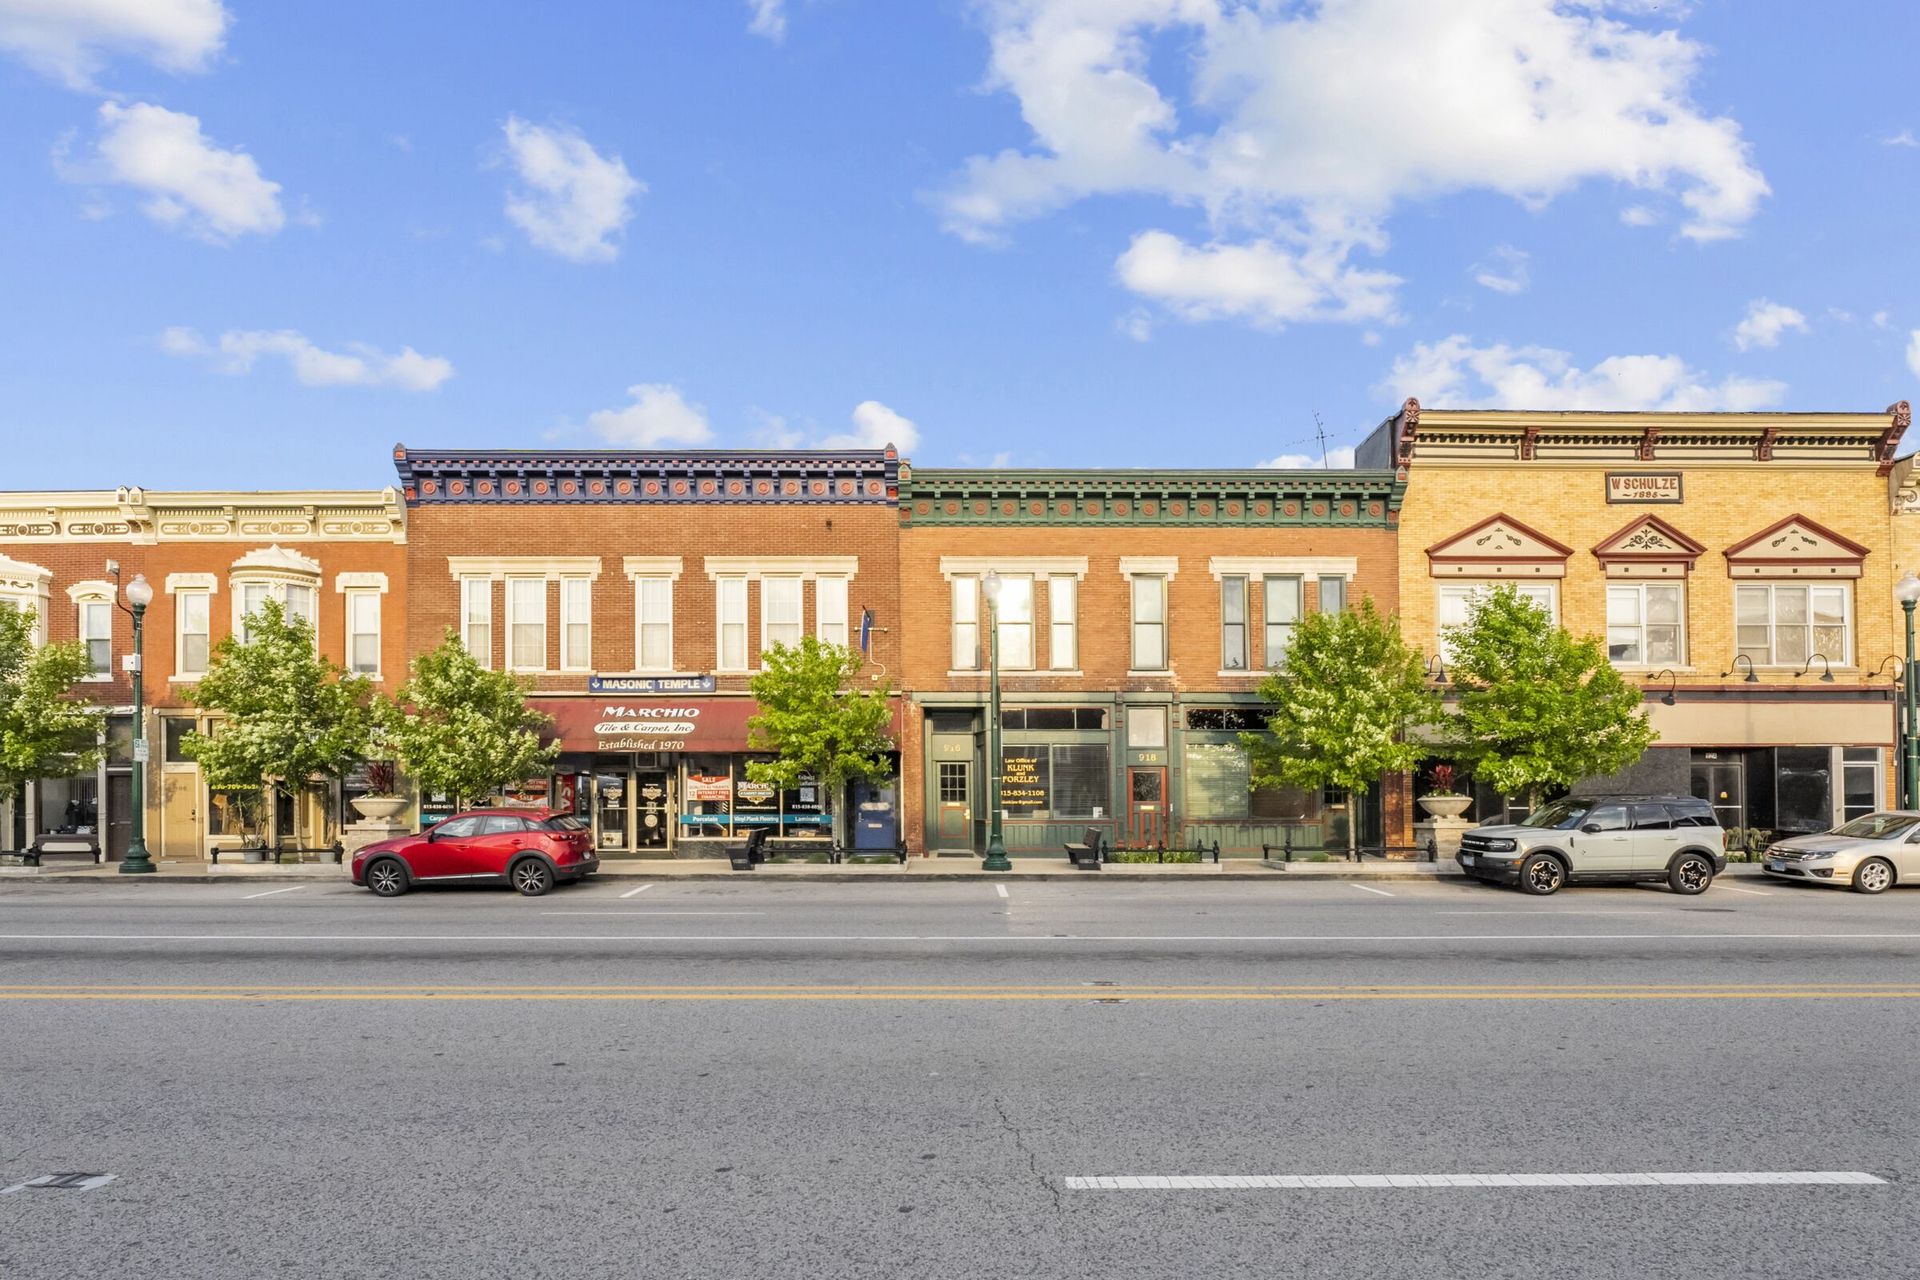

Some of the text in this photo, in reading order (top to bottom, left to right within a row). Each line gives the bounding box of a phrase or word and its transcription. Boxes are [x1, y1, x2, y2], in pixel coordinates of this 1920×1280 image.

[1611, 478, 1677, 490] W SCHULZE
[602, 680, 701, 689] MASONIC TEMPLE
[602, 706, 700, 718] MARCHIO
[598, 723, 618, 732] Tile
[620, 723, 630, 731] &
[673, 723, 693, 732] Inc.
[598, 738, 685, 750] Established 1970
[1138, 753, 1157, 762] 918
[1007, 764, 1035, 772] KLUNK
